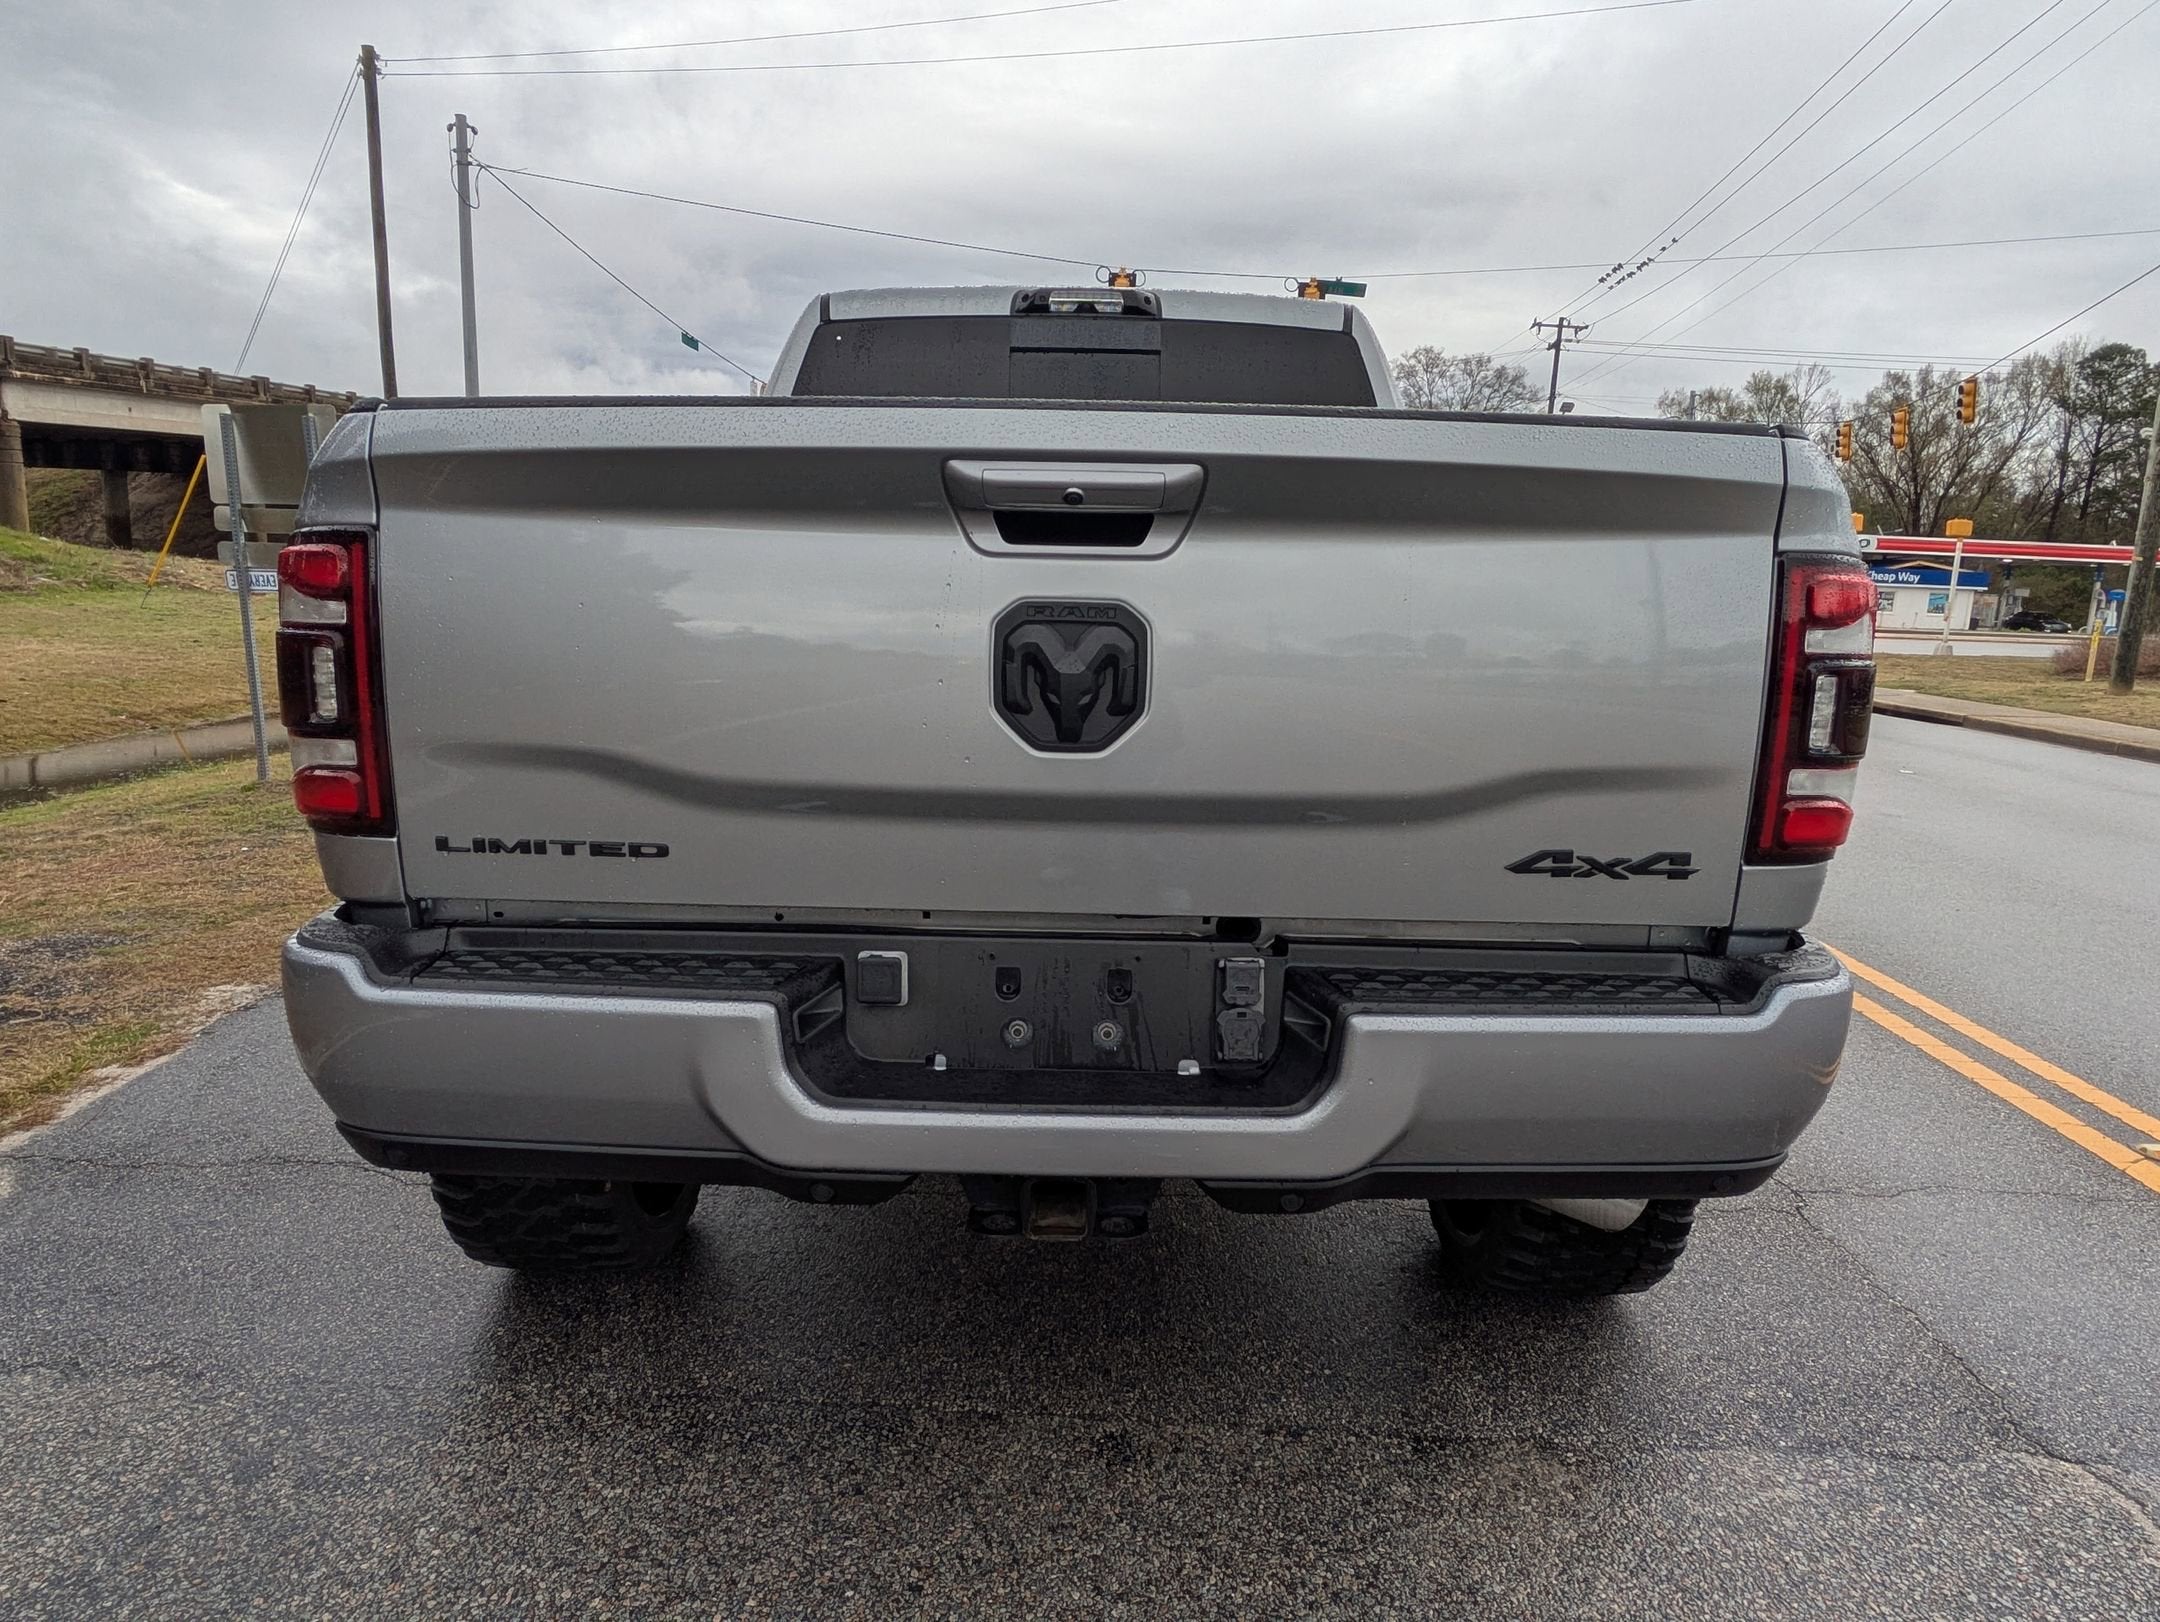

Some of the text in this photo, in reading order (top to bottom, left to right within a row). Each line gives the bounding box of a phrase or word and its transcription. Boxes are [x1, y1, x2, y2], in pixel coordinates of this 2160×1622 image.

[230, 574, 276, 587] EVERYE
[1898, 571, 1920, 583] Way
[1026, 605, 1117, 619] RAM
[434, 835, 670, 858] LIMITED
